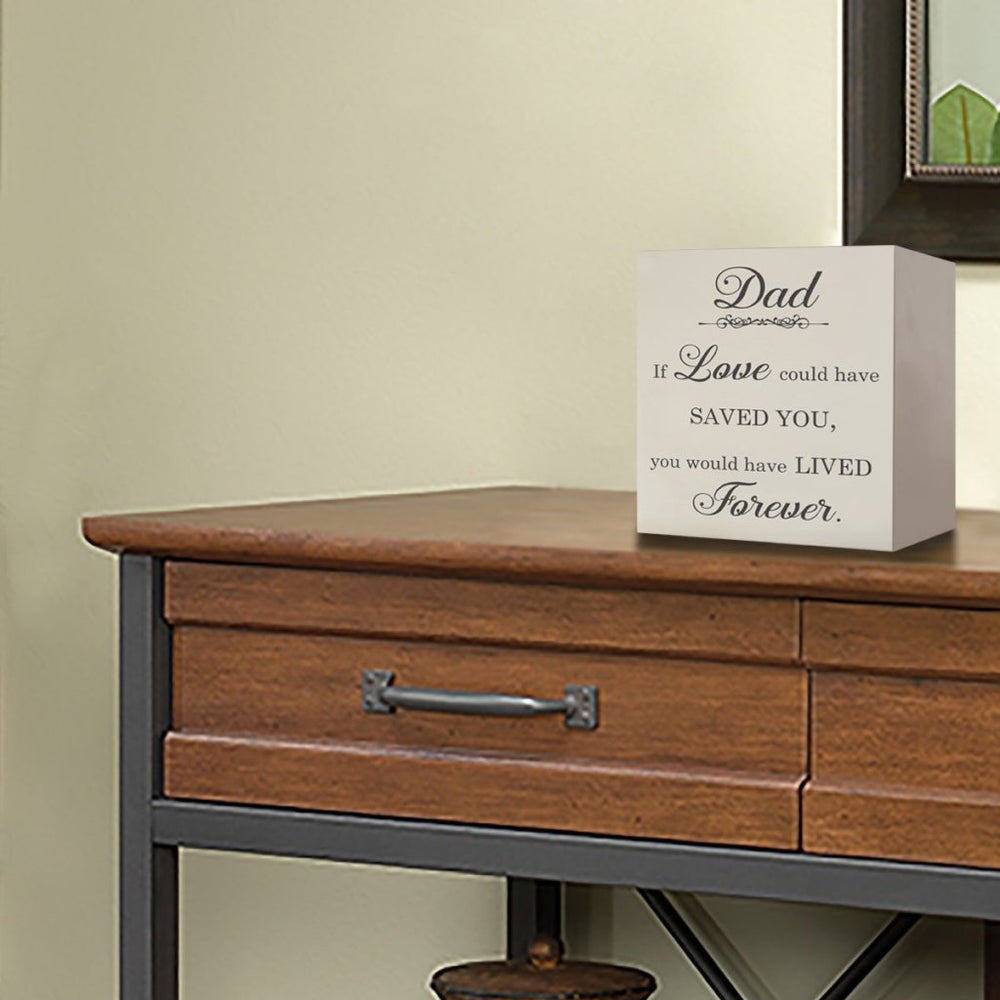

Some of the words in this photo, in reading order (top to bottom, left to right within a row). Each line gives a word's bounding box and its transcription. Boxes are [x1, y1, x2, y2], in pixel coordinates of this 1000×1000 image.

[713, 265, 823, 309] Dad
[652, 363, 669, 379] If
[673, 343, 772, 383] Love
[779, 366, 829, 382] could
[834, 368, 880, 383] have
[689, 406, 769, 427] SAVED
[775, 409, 837, 433] YOU,
[649, 456, 680, 471] you
[686, 455, 738, 471] would
[744, 457, 787, 473] have
[795, 456, 872, 477] LIVED
[692, 481, 842, 523] Forever.
